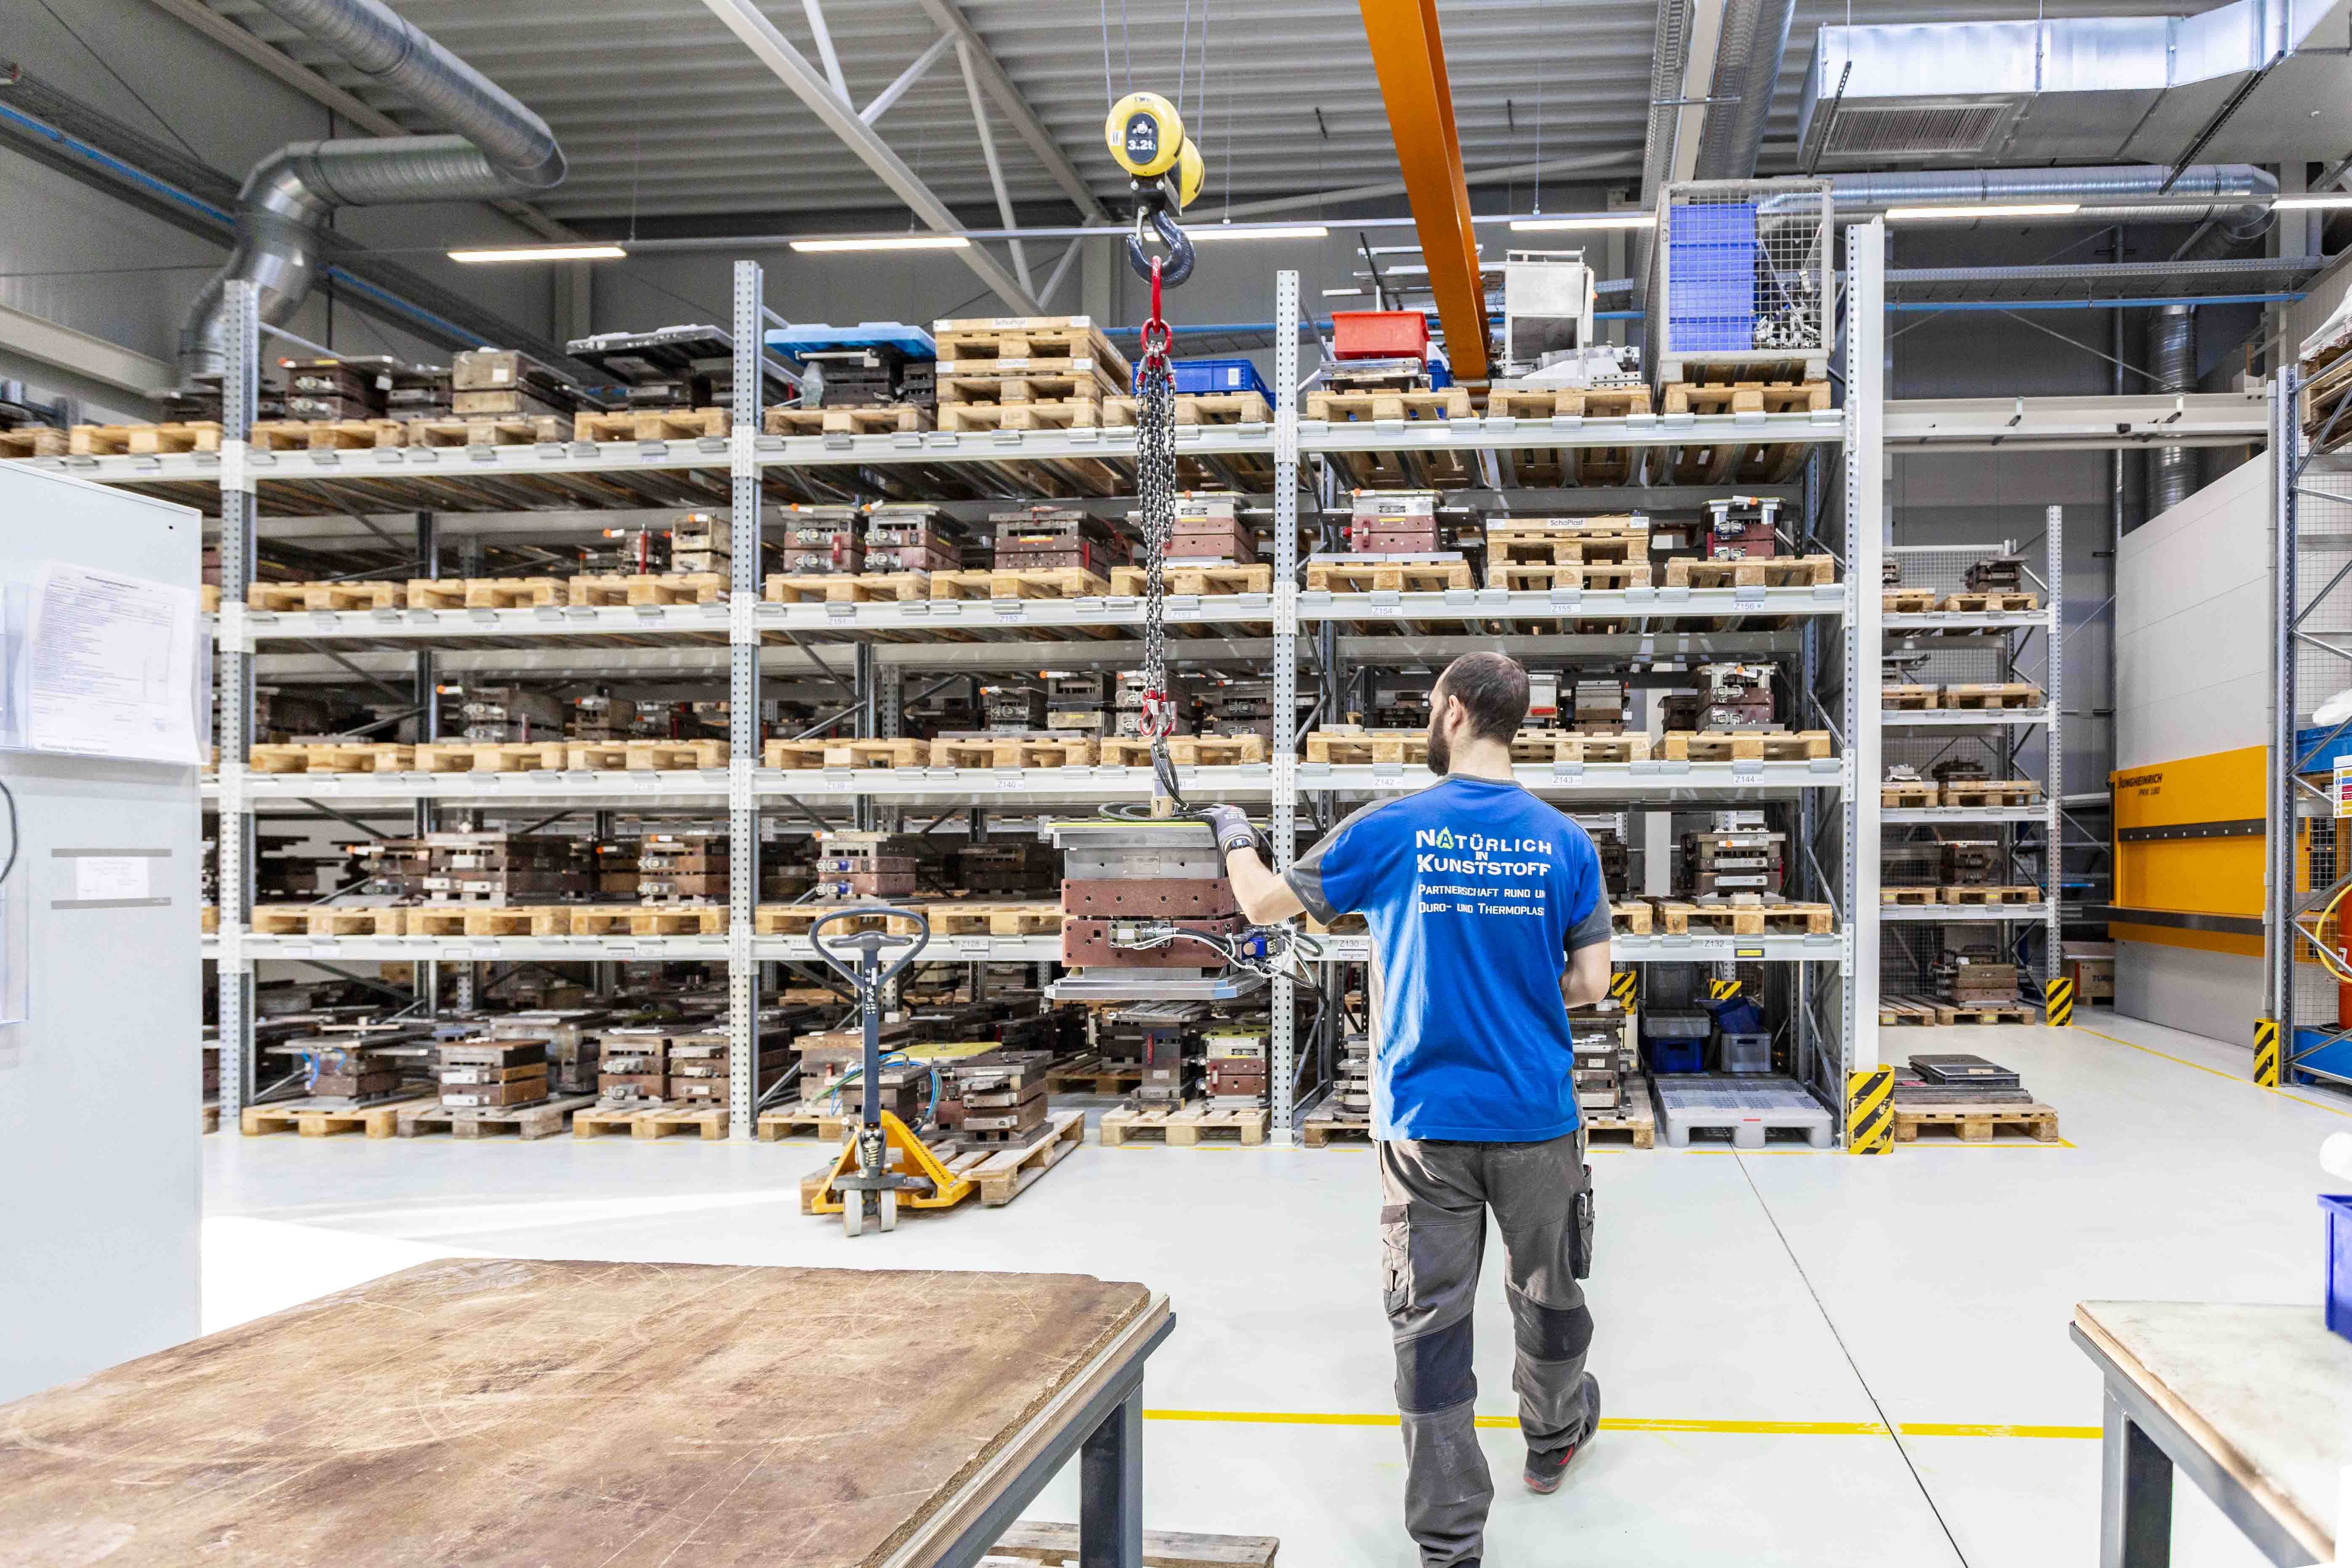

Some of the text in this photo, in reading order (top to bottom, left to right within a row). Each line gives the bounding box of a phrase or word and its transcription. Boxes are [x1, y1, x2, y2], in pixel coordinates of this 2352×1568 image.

[1374, 778, 1394, 786] Z142
[1553, 776, 1573, 784] Z143
[1475, 851, 1488, 861] IN
[1417, 854, 1551, 876] KUNSTSTOFF
[1504, 888, 1530, 898] RUND
[1418, 902, 1452, 913] DURO-
[1457, 903, 1473, 913] UND
